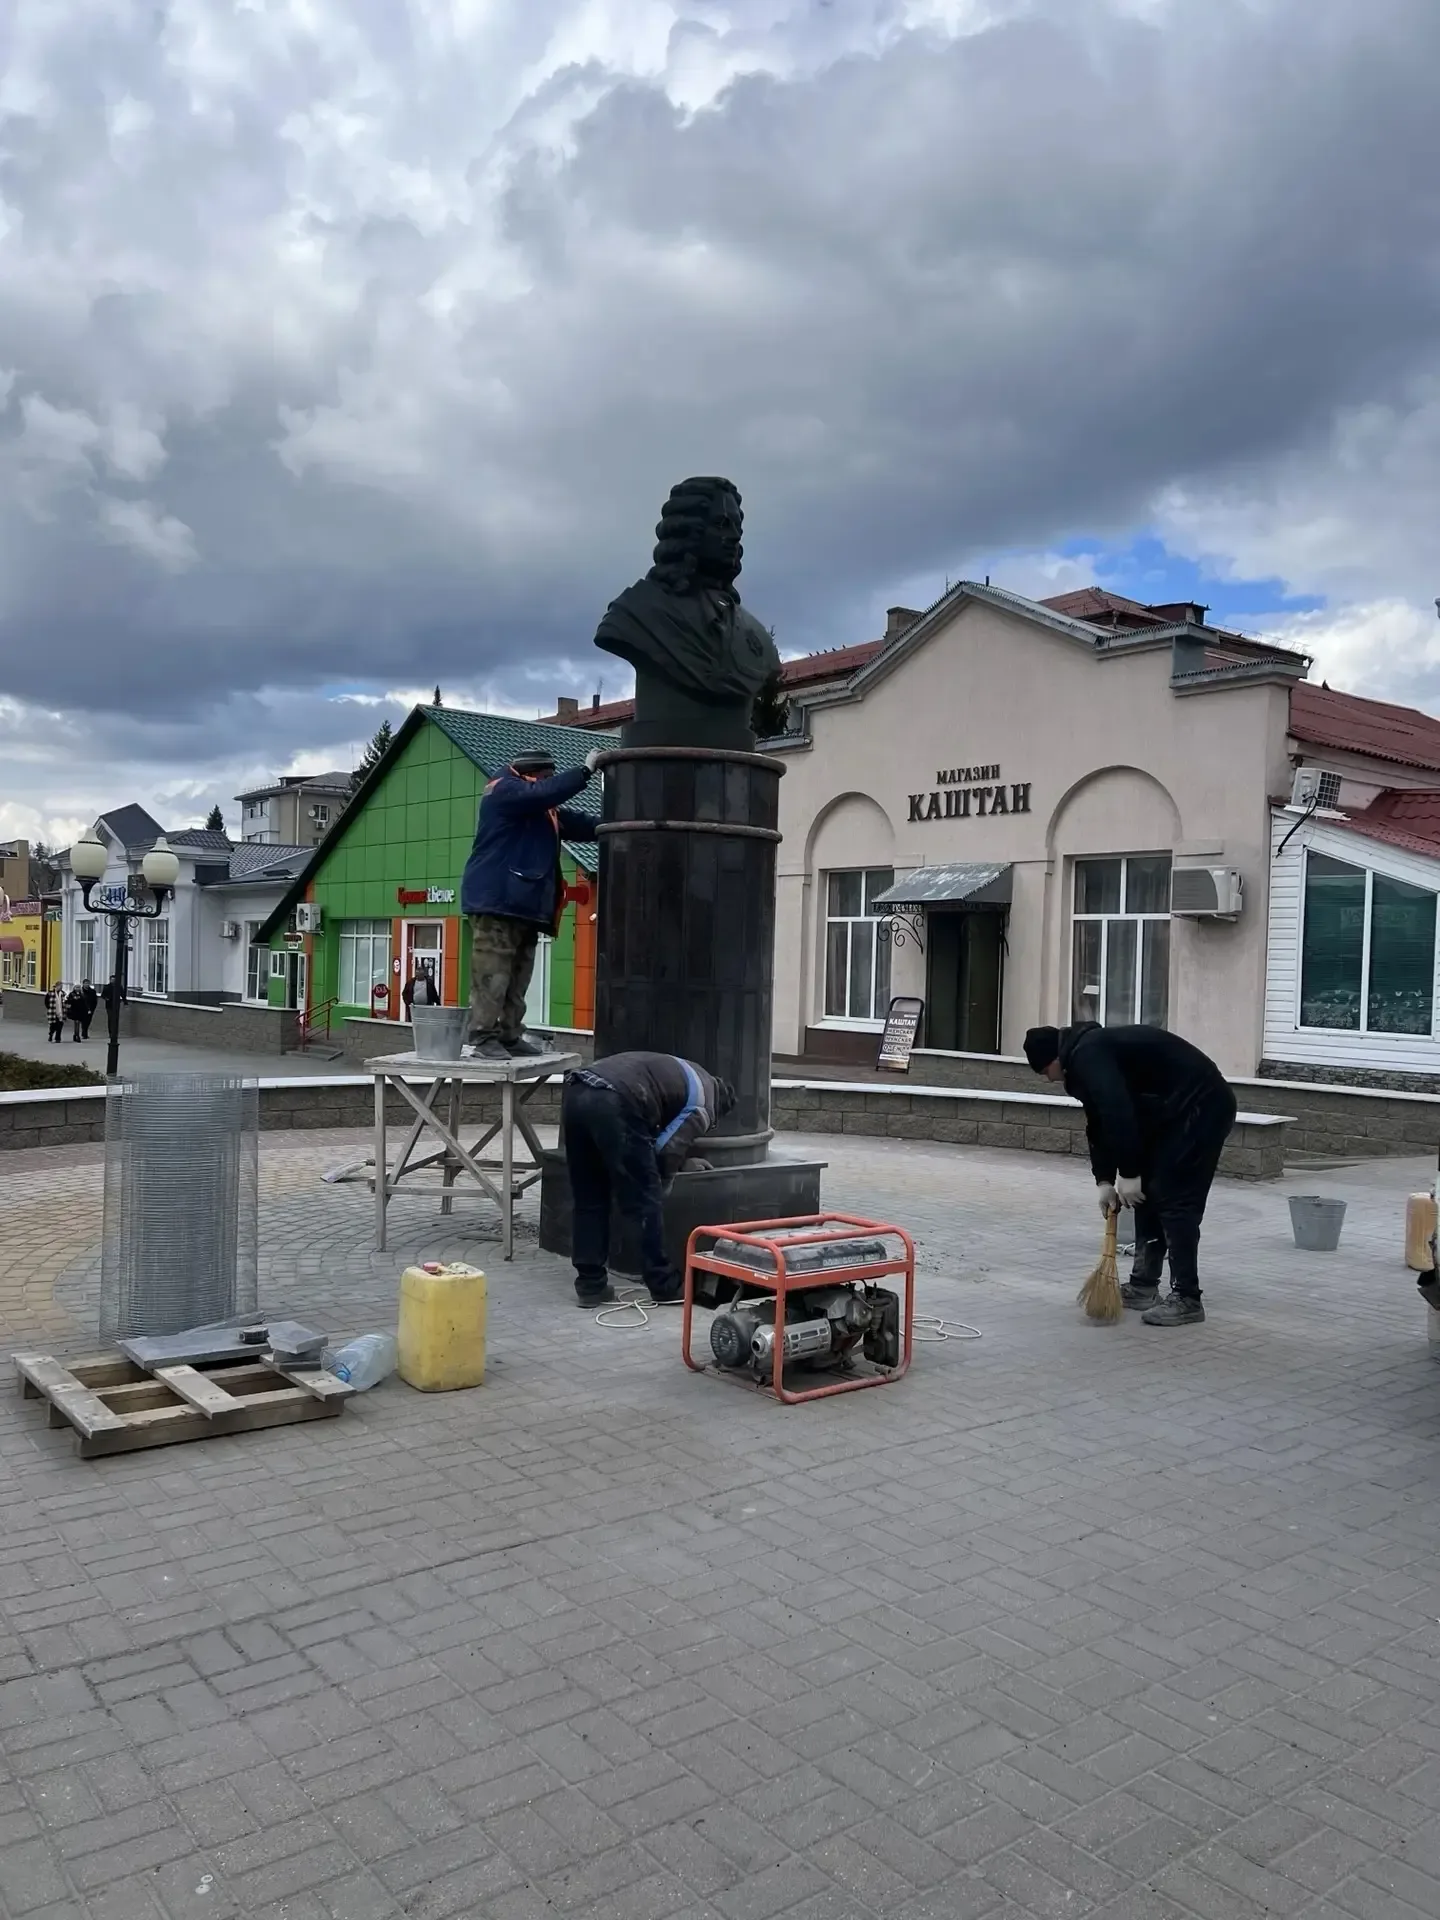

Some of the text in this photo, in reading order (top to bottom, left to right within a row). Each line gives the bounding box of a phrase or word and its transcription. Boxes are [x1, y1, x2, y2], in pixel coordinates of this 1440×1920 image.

[936, 764, 1000, 785] МАГАЗИН
[907, 783, 1031, 822] КАШТАН
[889, 1018, 916, 1026] КАШТАН
